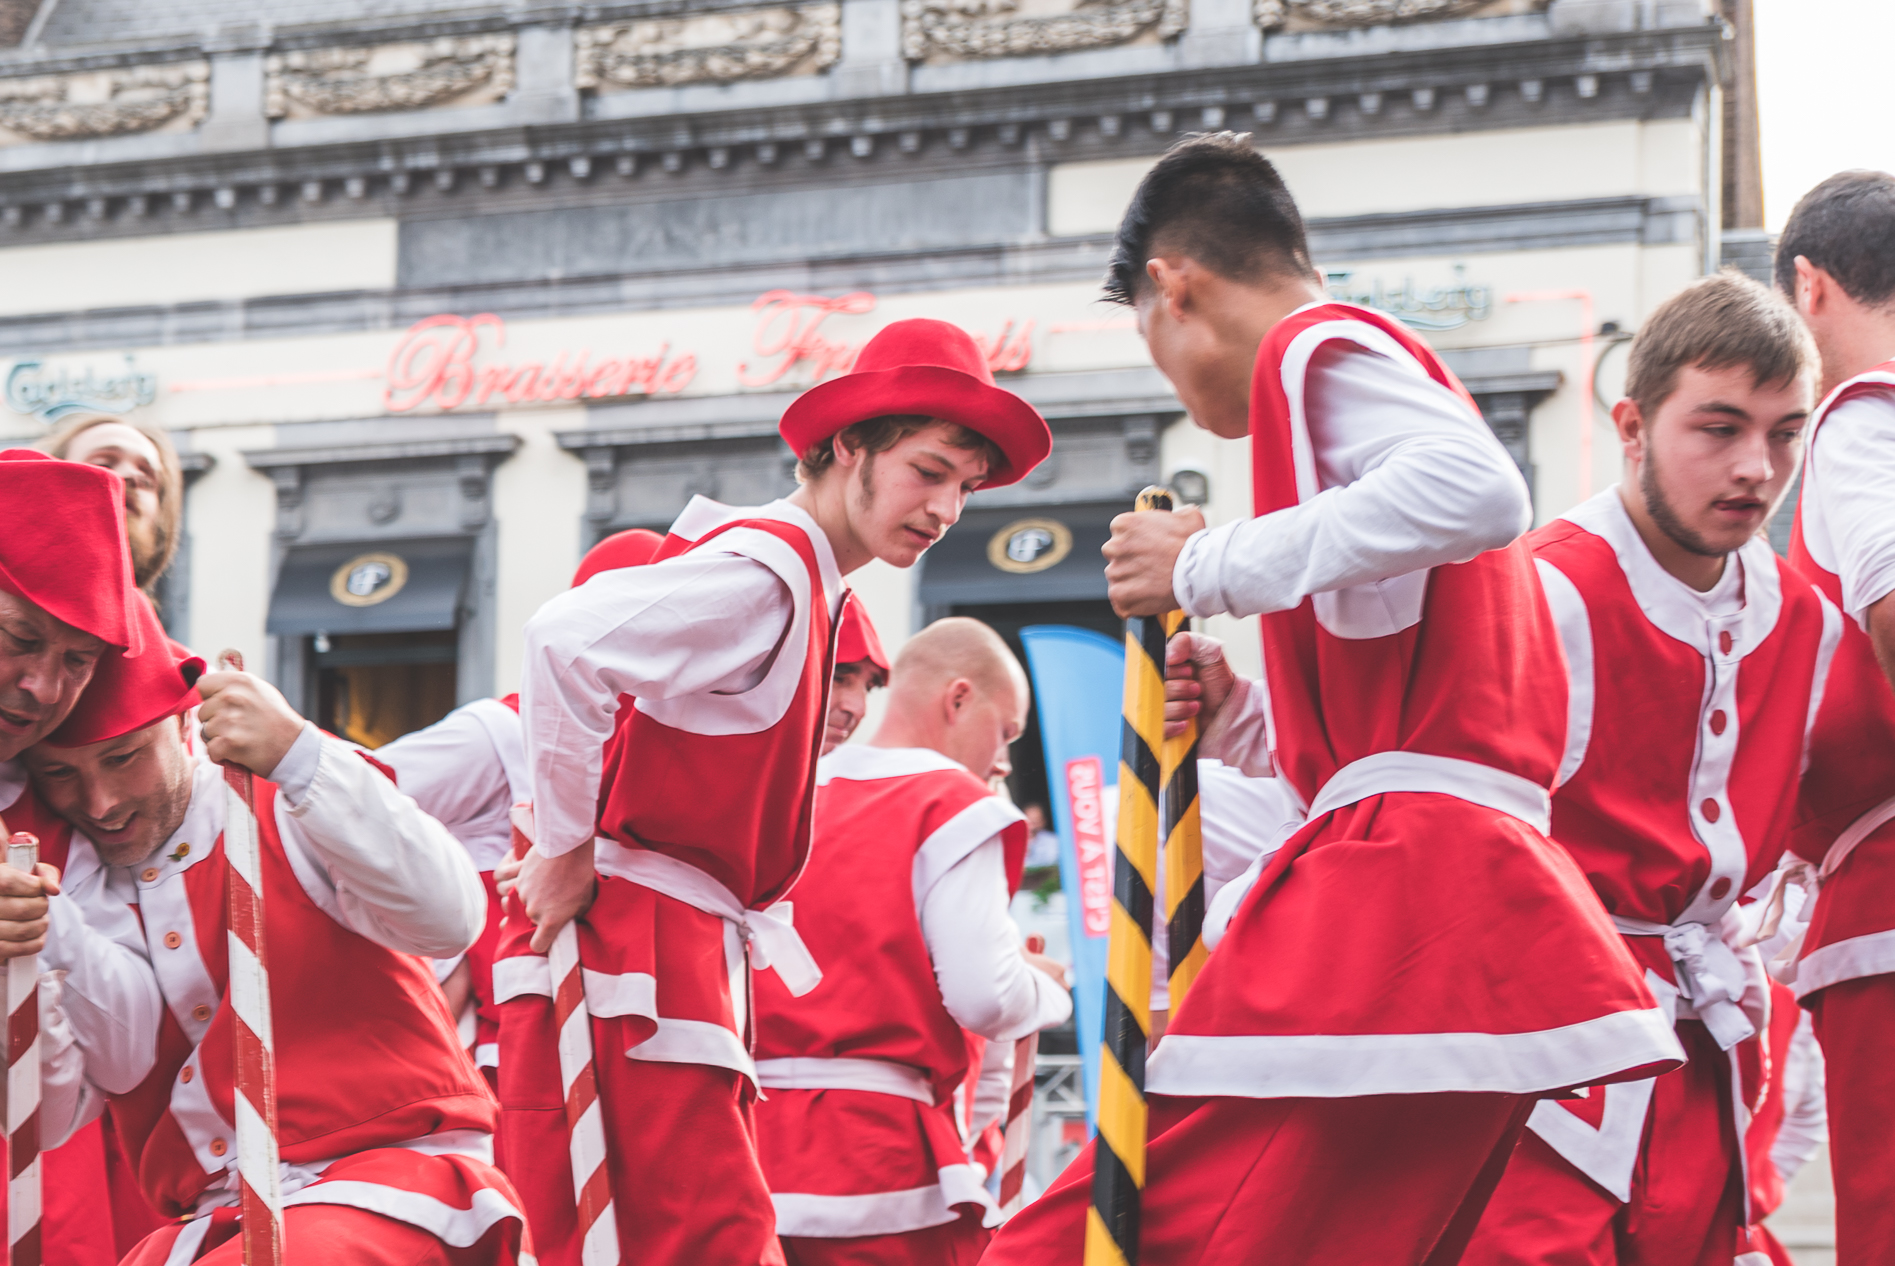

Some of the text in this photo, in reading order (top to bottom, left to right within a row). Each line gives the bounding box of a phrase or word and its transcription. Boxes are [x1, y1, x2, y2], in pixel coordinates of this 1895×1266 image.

[5, 358, 156, 415] Carlsberg
[383, 289, 1036, 412] Brasserie Frais
